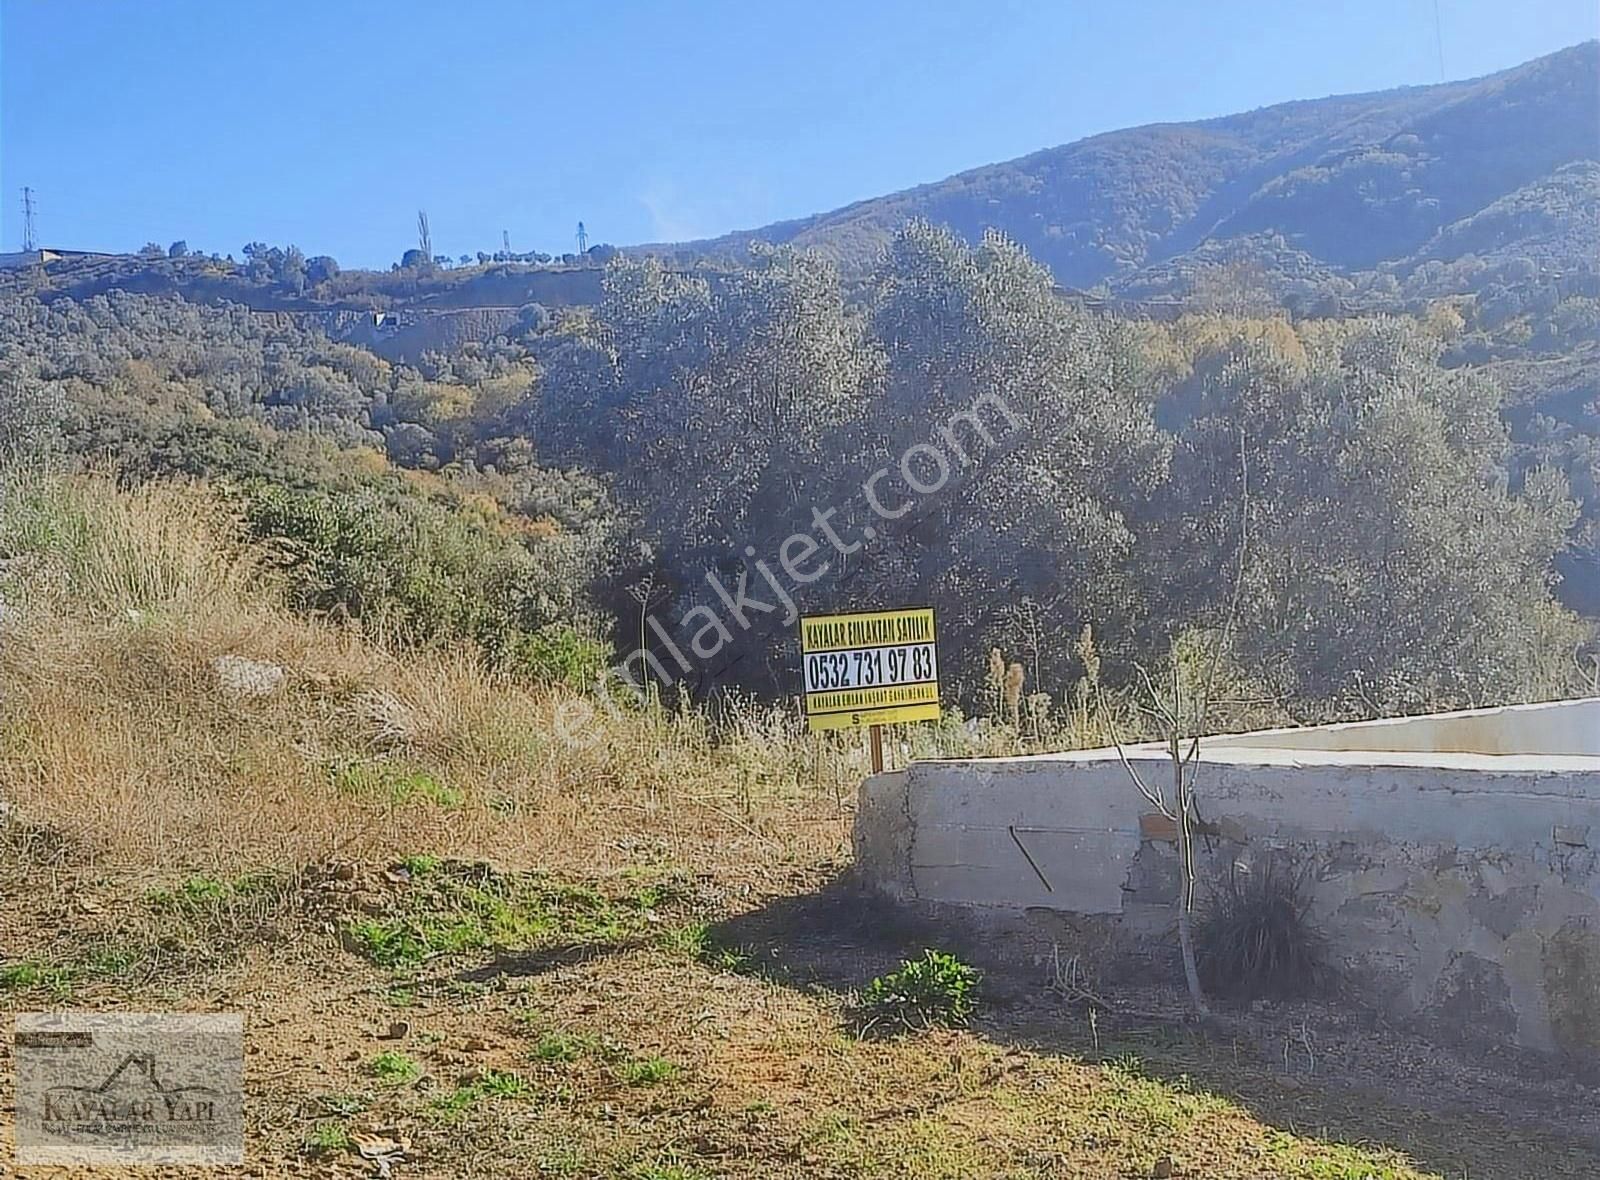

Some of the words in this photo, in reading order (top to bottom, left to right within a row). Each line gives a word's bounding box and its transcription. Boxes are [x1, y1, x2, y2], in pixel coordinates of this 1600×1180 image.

[806, 622, 847, 649] KAYALAR
[896, 615, 930, 642] SATILIK
[809, 653, 850, 689] 0532
[853, 650, 882, 685] 731
[888, 648, 906, 682] 97
[912, 646, 932, 679] 83
